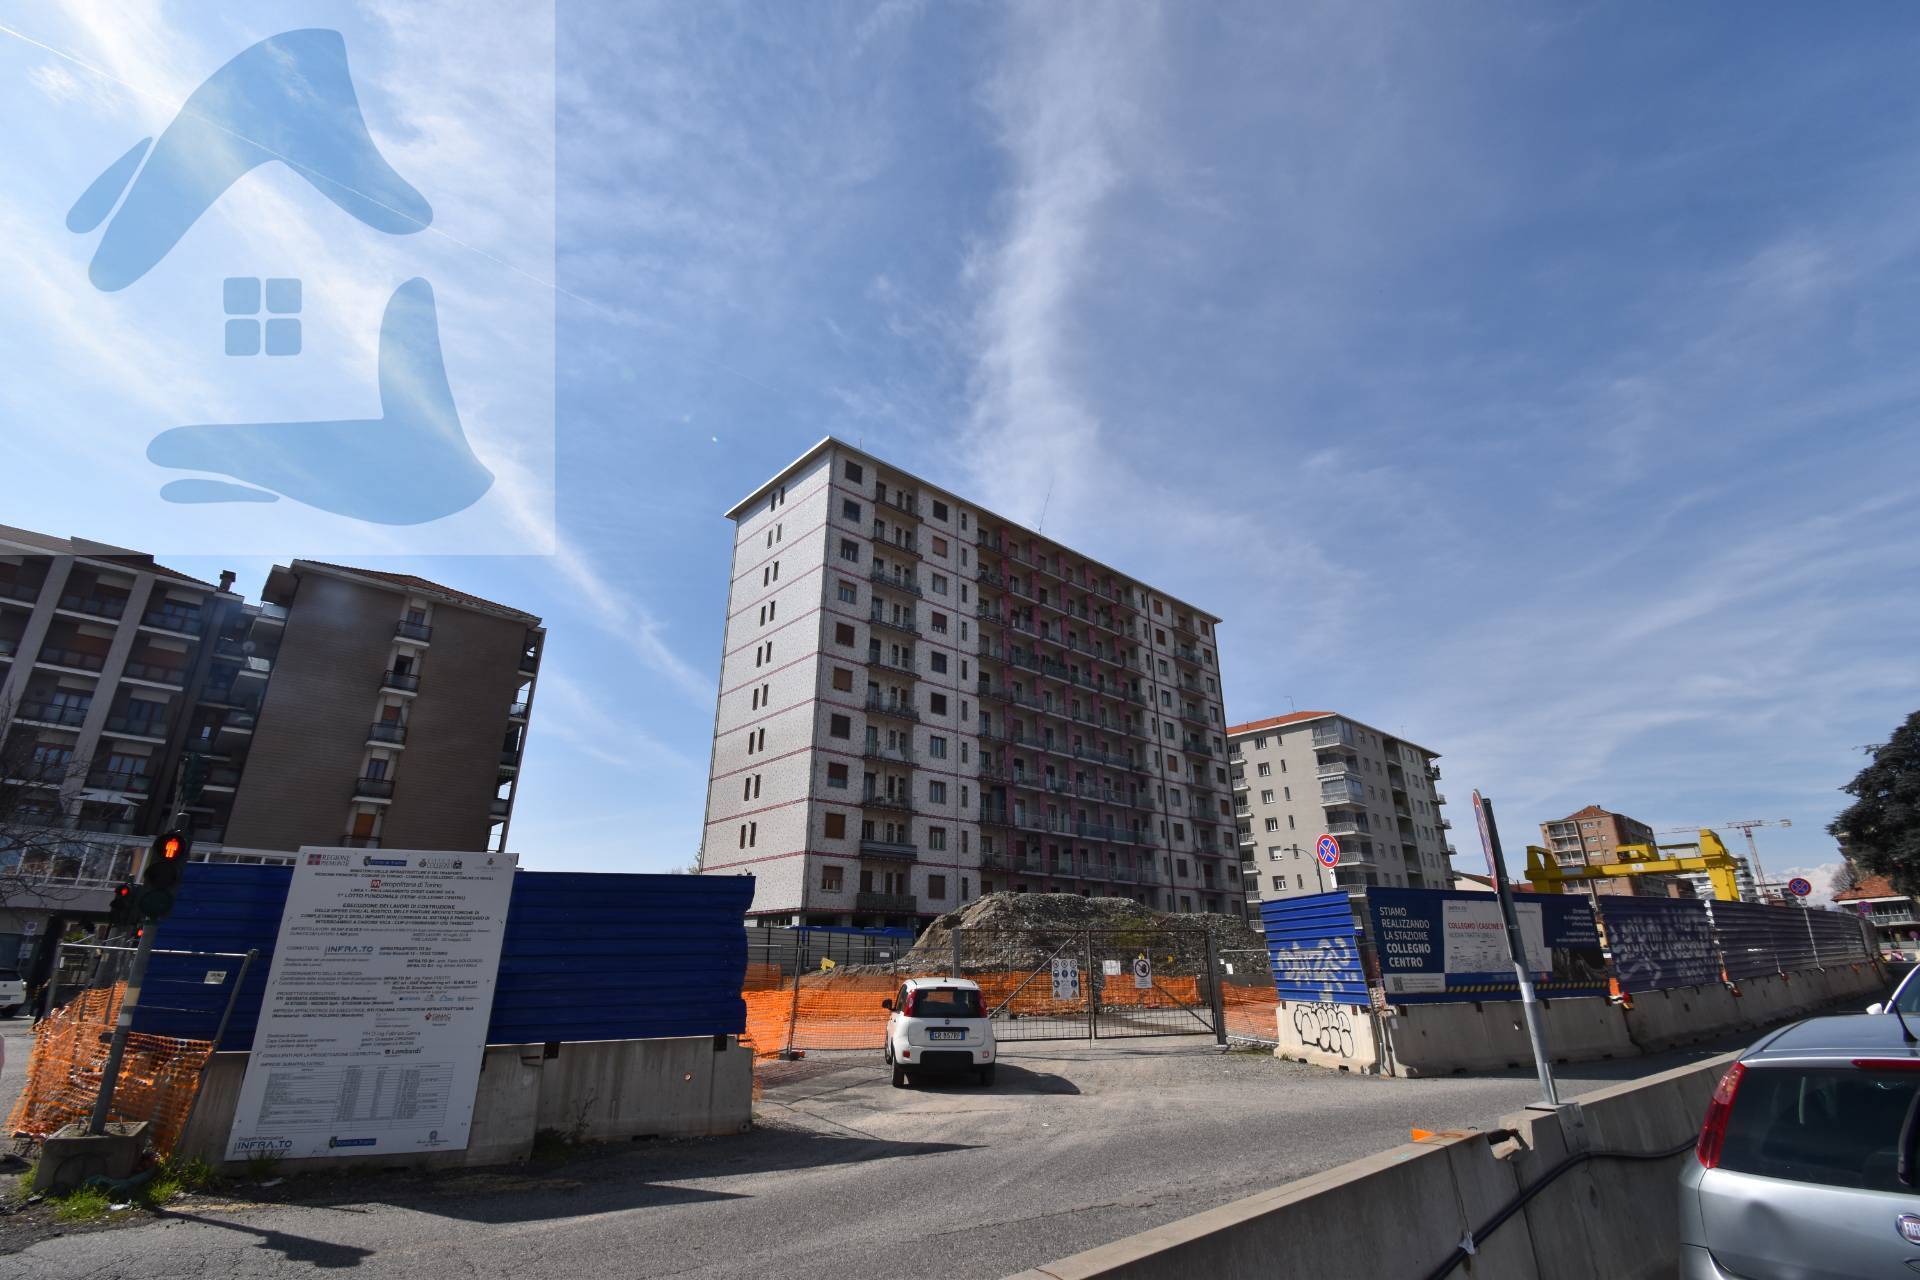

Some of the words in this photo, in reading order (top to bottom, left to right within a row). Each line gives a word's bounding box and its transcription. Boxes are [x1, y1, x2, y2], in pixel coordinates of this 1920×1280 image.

[371, 879, 416, 889] Metropolitana
[424, 881, 442, 889] Torino
[1379, 906, 1407, 917] STIAMO
[1381, 918, 1430, 929] REALIZZANDO
[1447, 922, 1475, 930] COLLEGNO
[1384, 931, 1394, 940] LA
[1394, 931, 1428, 941] STAZIONE
[327, 945, 374, 953] INFRA.TO
[1386, 943, 1431, 954] COLLEGNO
[1388, 957, 1423, 968] CENTRO
[237, 1140, 292, 1150] INFRA.TO
[1903, 1221, 1920, 1237] FIA
